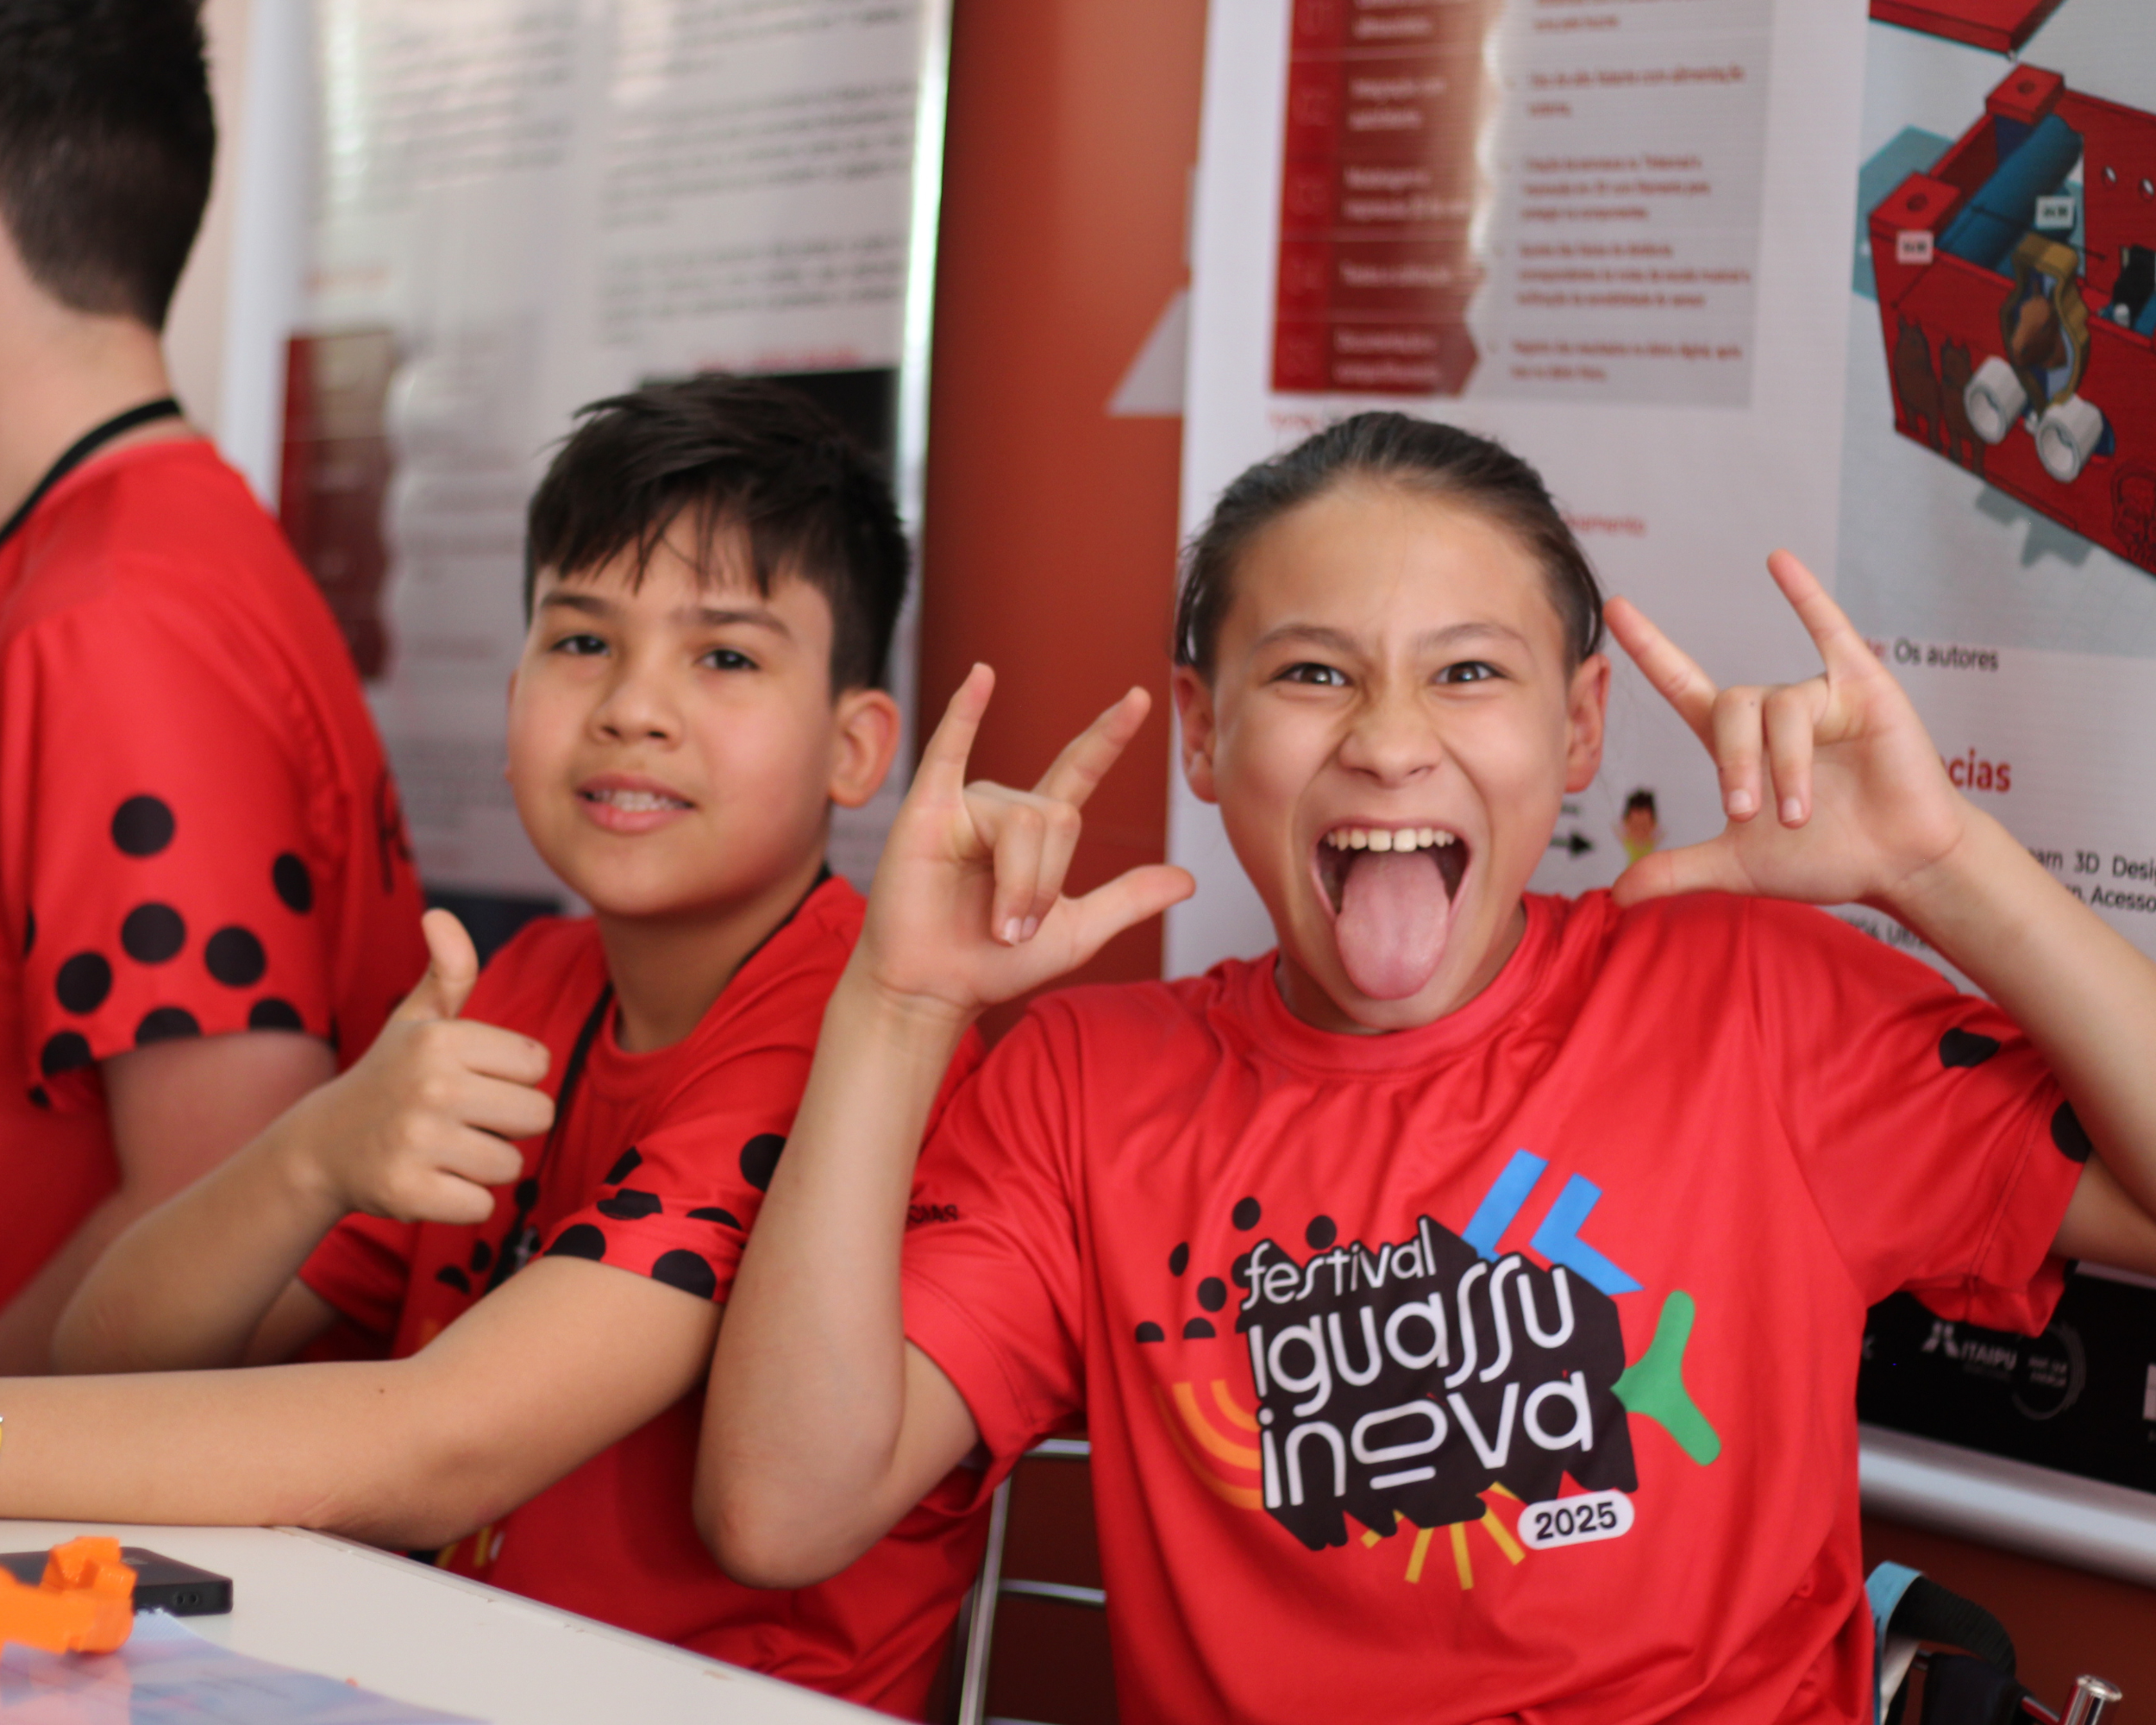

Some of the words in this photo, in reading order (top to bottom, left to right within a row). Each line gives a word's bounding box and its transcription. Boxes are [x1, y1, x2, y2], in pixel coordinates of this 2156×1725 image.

[1895, 637, 1921, 666] Os
[1927, 646, 2000, 672] autores
[1941, 747, 2012, 794] cias
[2074, 849, 2101, 875] 3D
[2090, 885, 2156, 913] Acesso
[1242, 1215, 1438, 1310] festival
[1960, 1339, 2018, 1371] ITAIPU
[1257, 1370, 1594, 1509] inova
[1534, 1501, 1619, 1541] 2025
